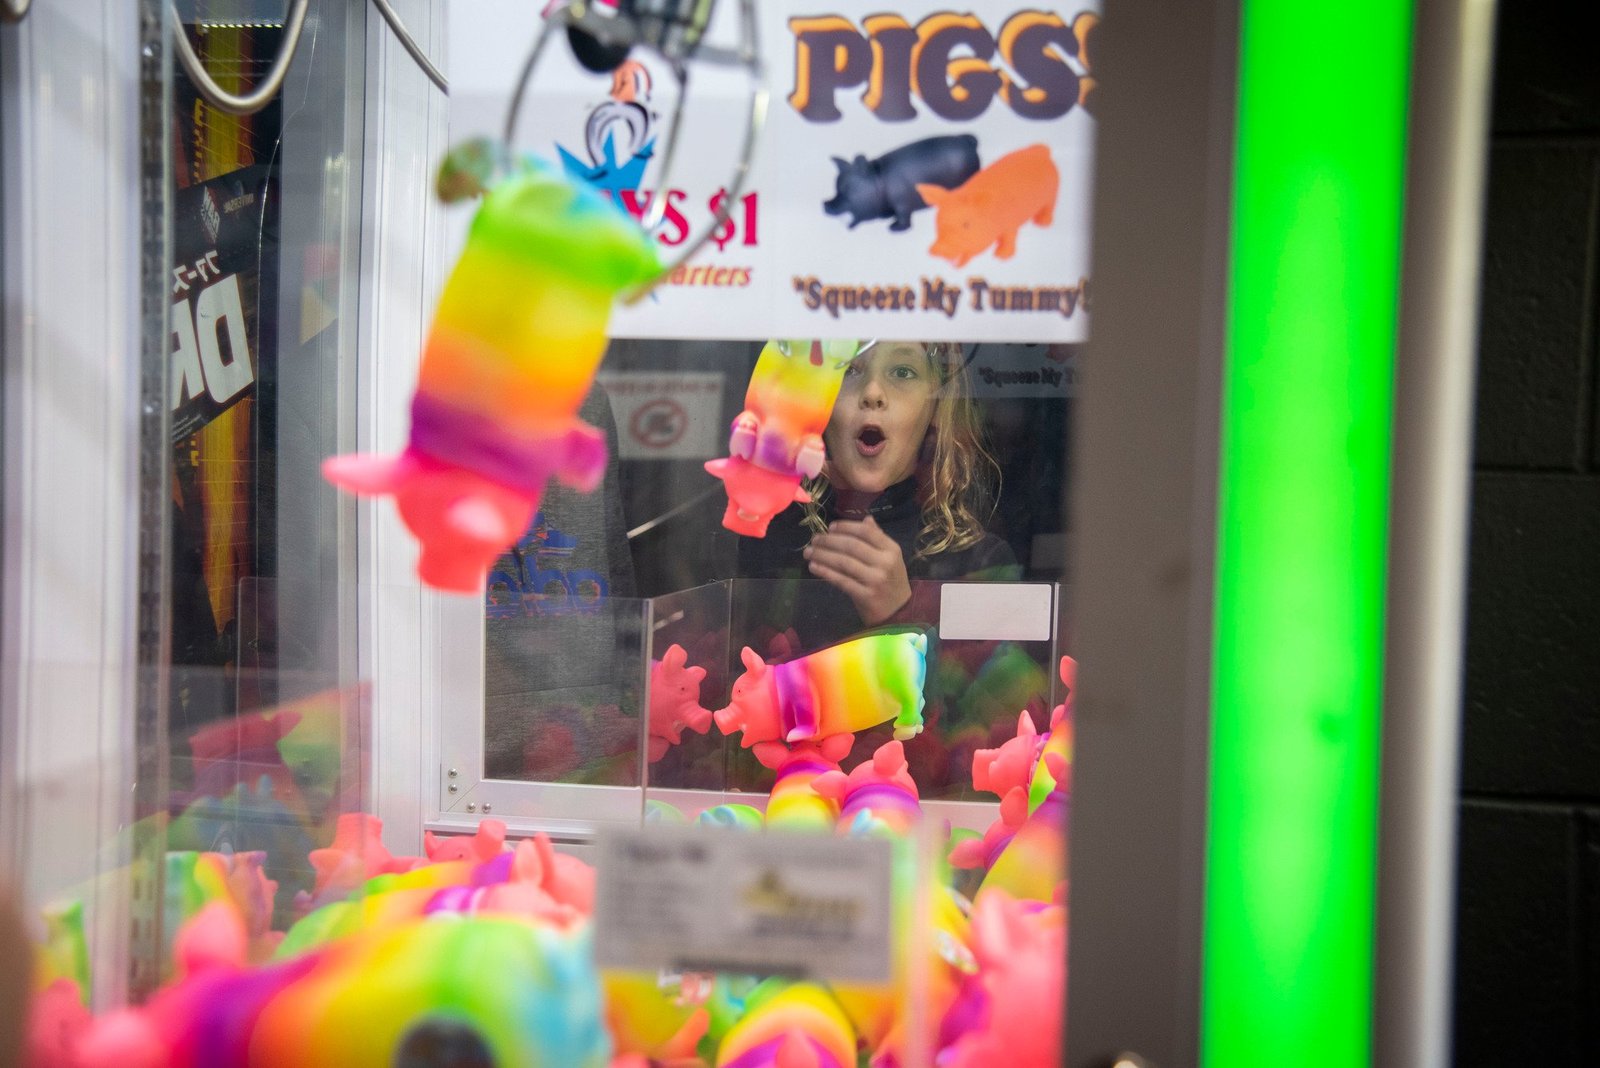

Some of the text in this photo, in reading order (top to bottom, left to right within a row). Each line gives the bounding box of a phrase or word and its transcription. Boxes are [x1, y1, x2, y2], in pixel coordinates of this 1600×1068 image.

[787, 9, 1097, 123] PIGS
[708, 187, 758, 251] $1
[920, 278, 961, 319] My
